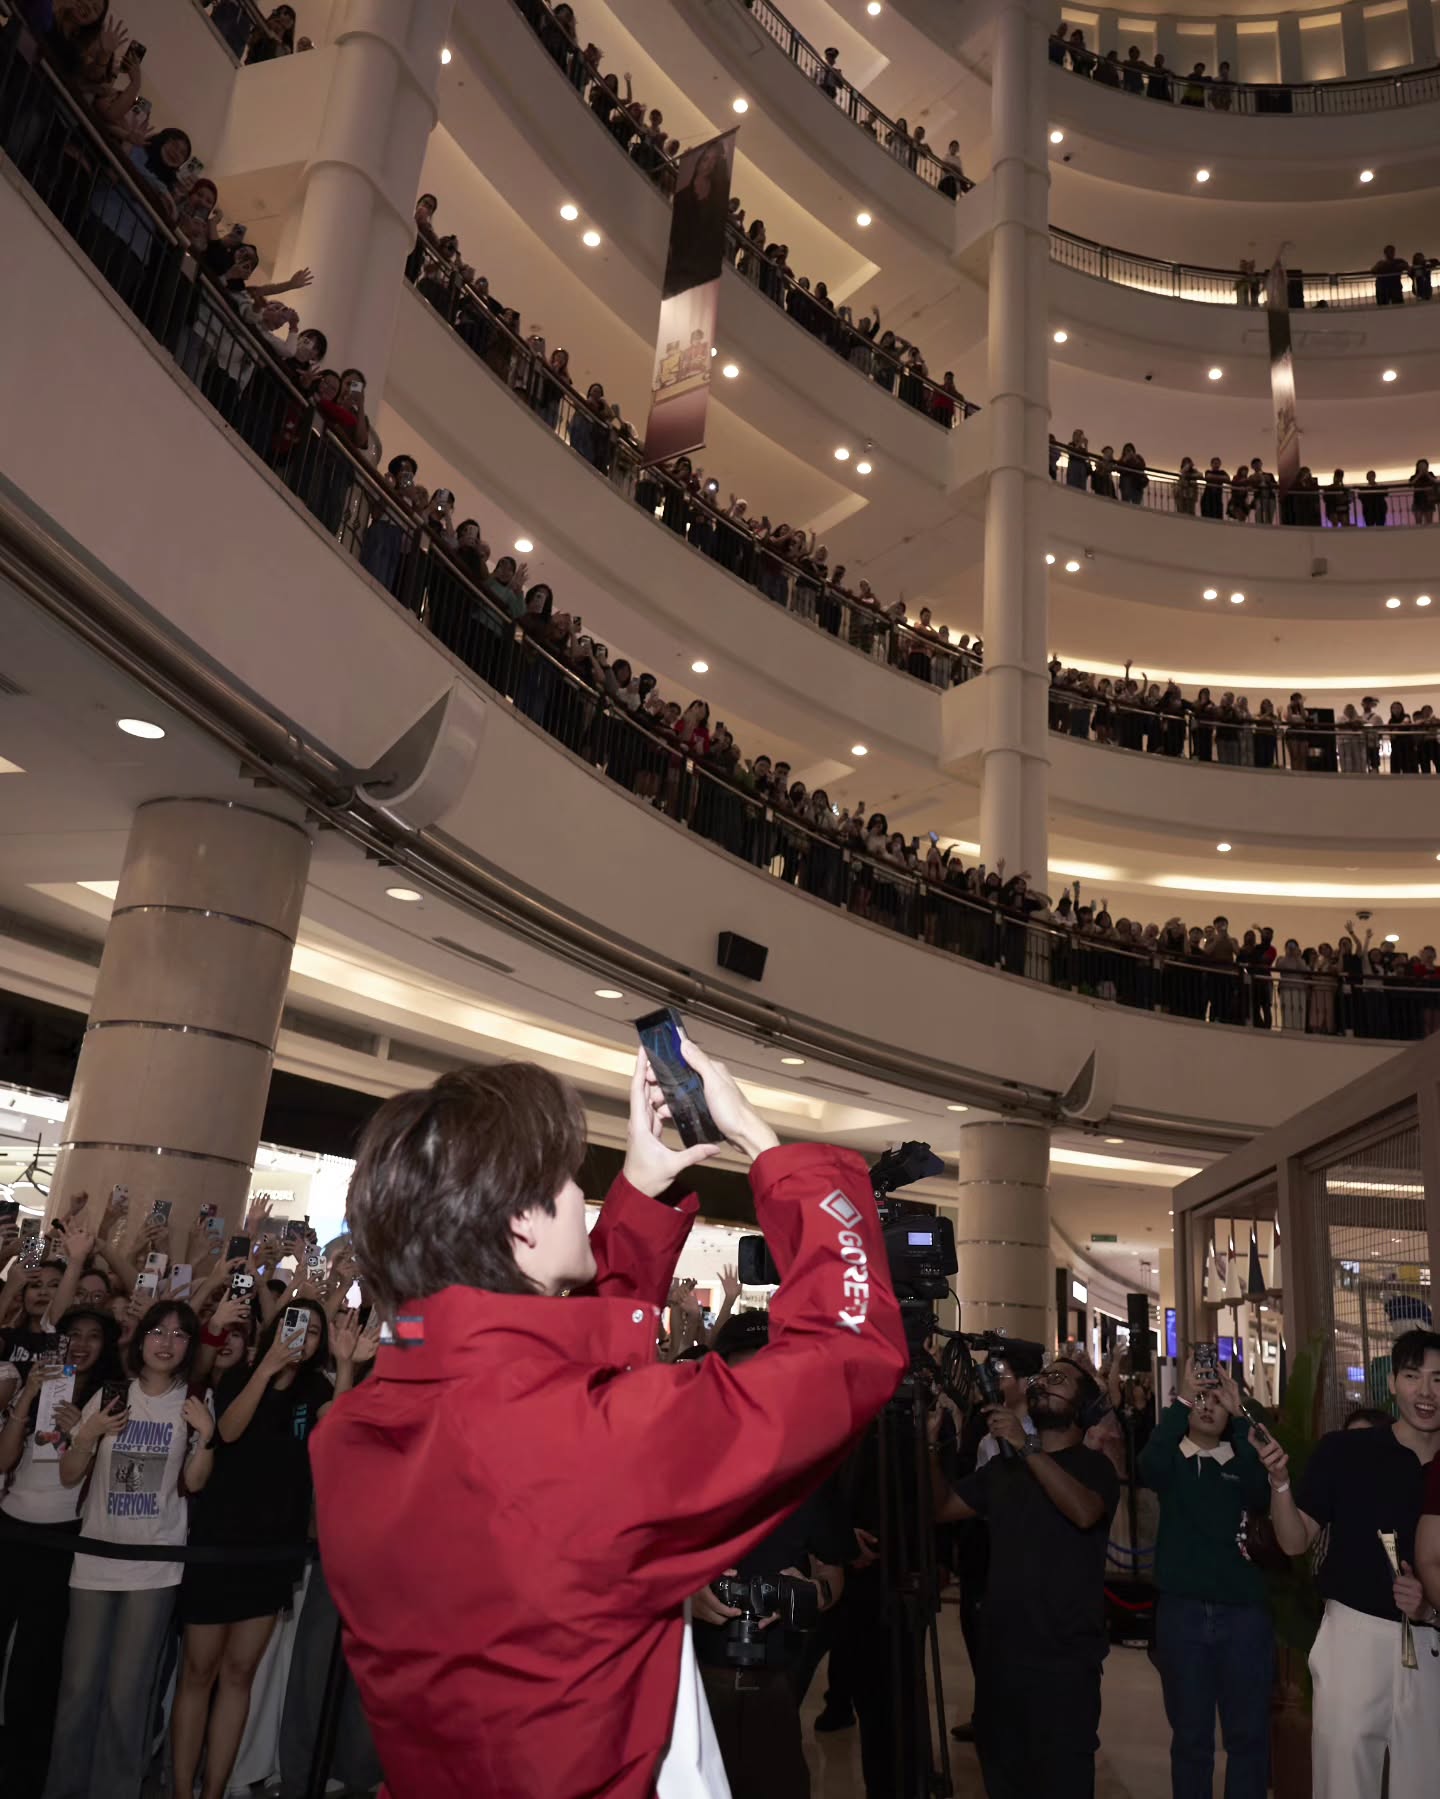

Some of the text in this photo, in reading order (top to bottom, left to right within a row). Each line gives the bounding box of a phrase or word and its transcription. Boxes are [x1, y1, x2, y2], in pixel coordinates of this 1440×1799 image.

[116, 1420, 173, 1446] WINNING
[112, 1443, 170, 1453] ISN'T FOR
[107, 1492, 160, 1517] EVERYONE.
